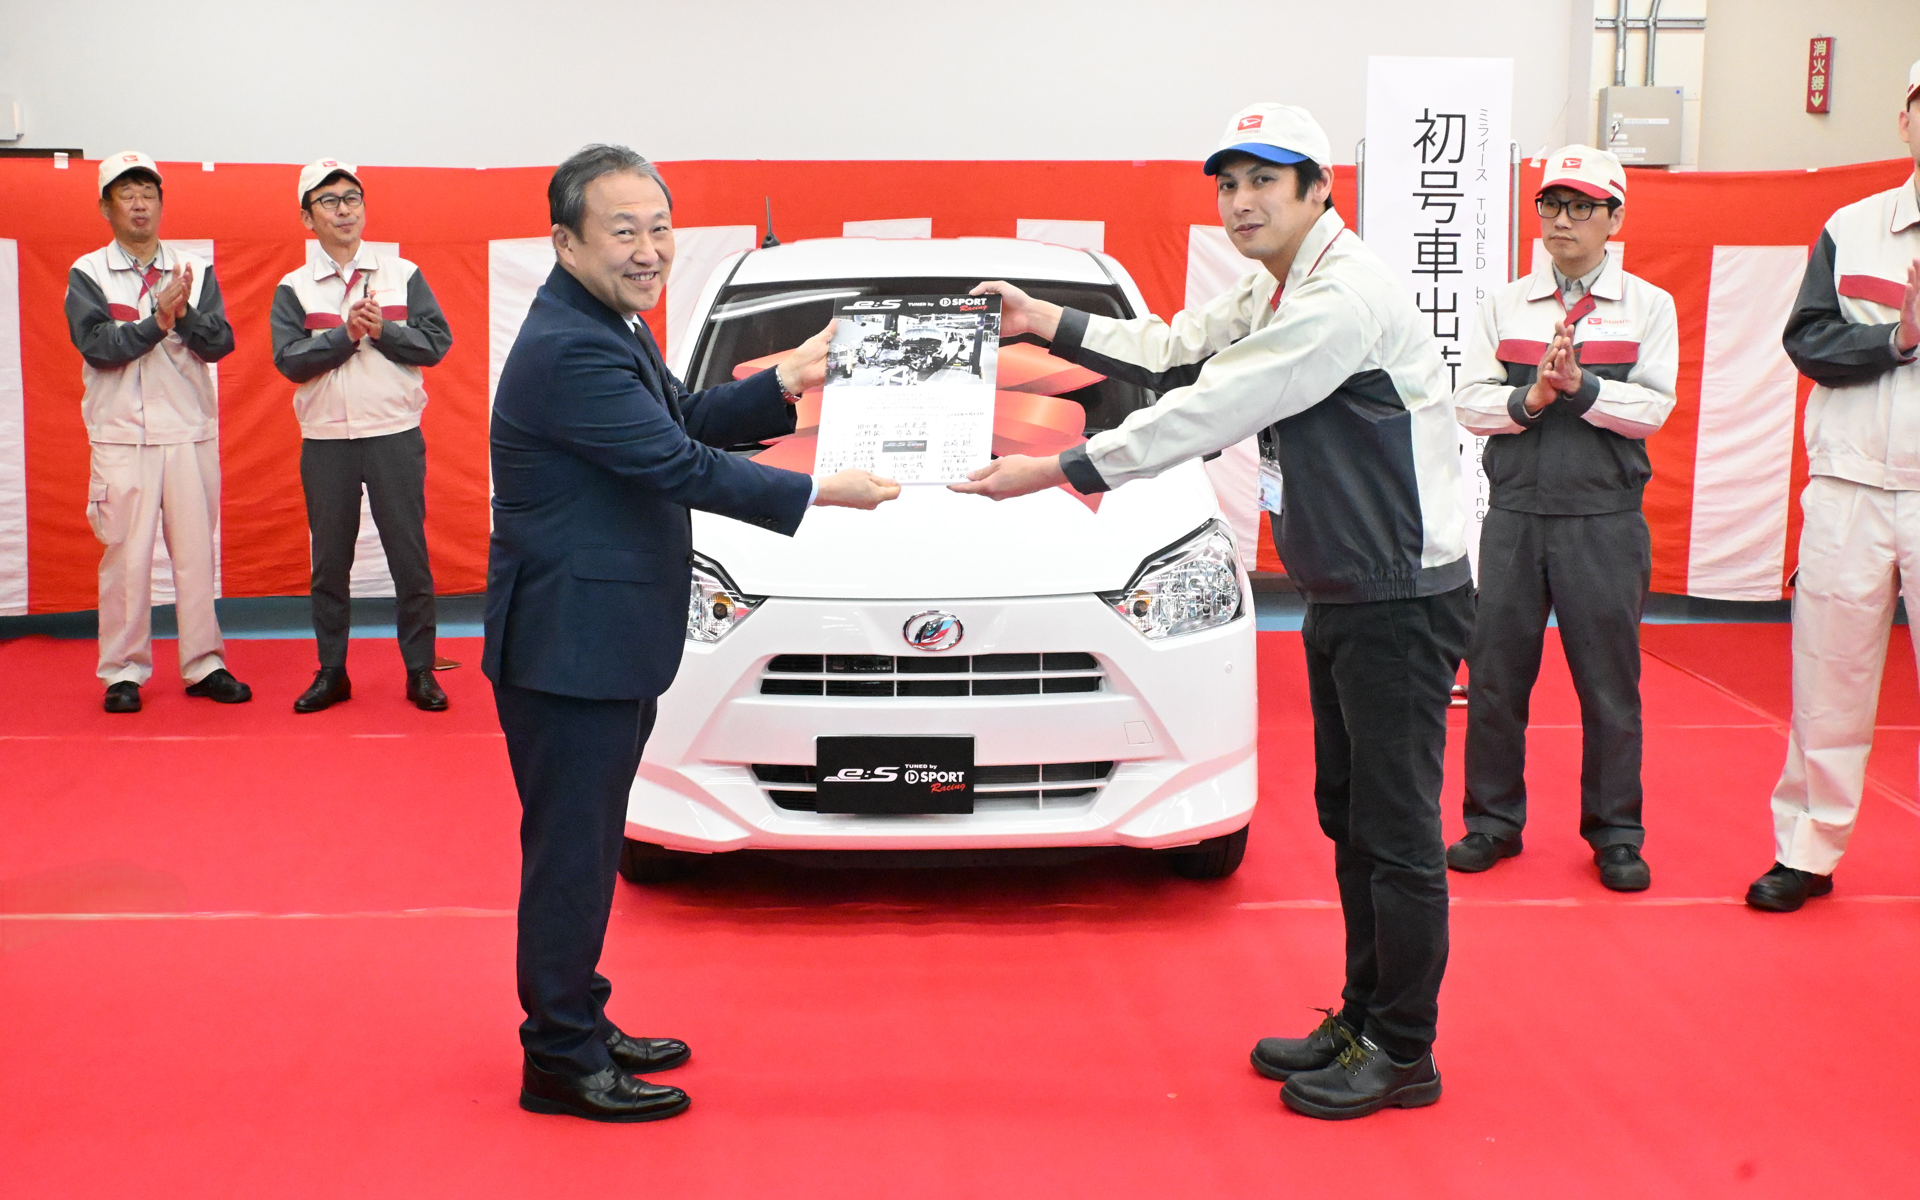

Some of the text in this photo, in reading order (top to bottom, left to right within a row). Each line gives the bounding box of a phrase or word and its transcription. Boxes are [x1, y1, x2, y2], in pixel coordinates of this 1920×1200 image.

[1811, 40, 1827, 91] 消火器
[1411, 107, 1466, 456] 初号車出
[951, 298, 987, 306] SPORT
[1474, 108, 1489, 524] ミライース TUNED b Racing
[920, 771, 965, 783] SPORT
[930, 782, 966, 794] Racing
